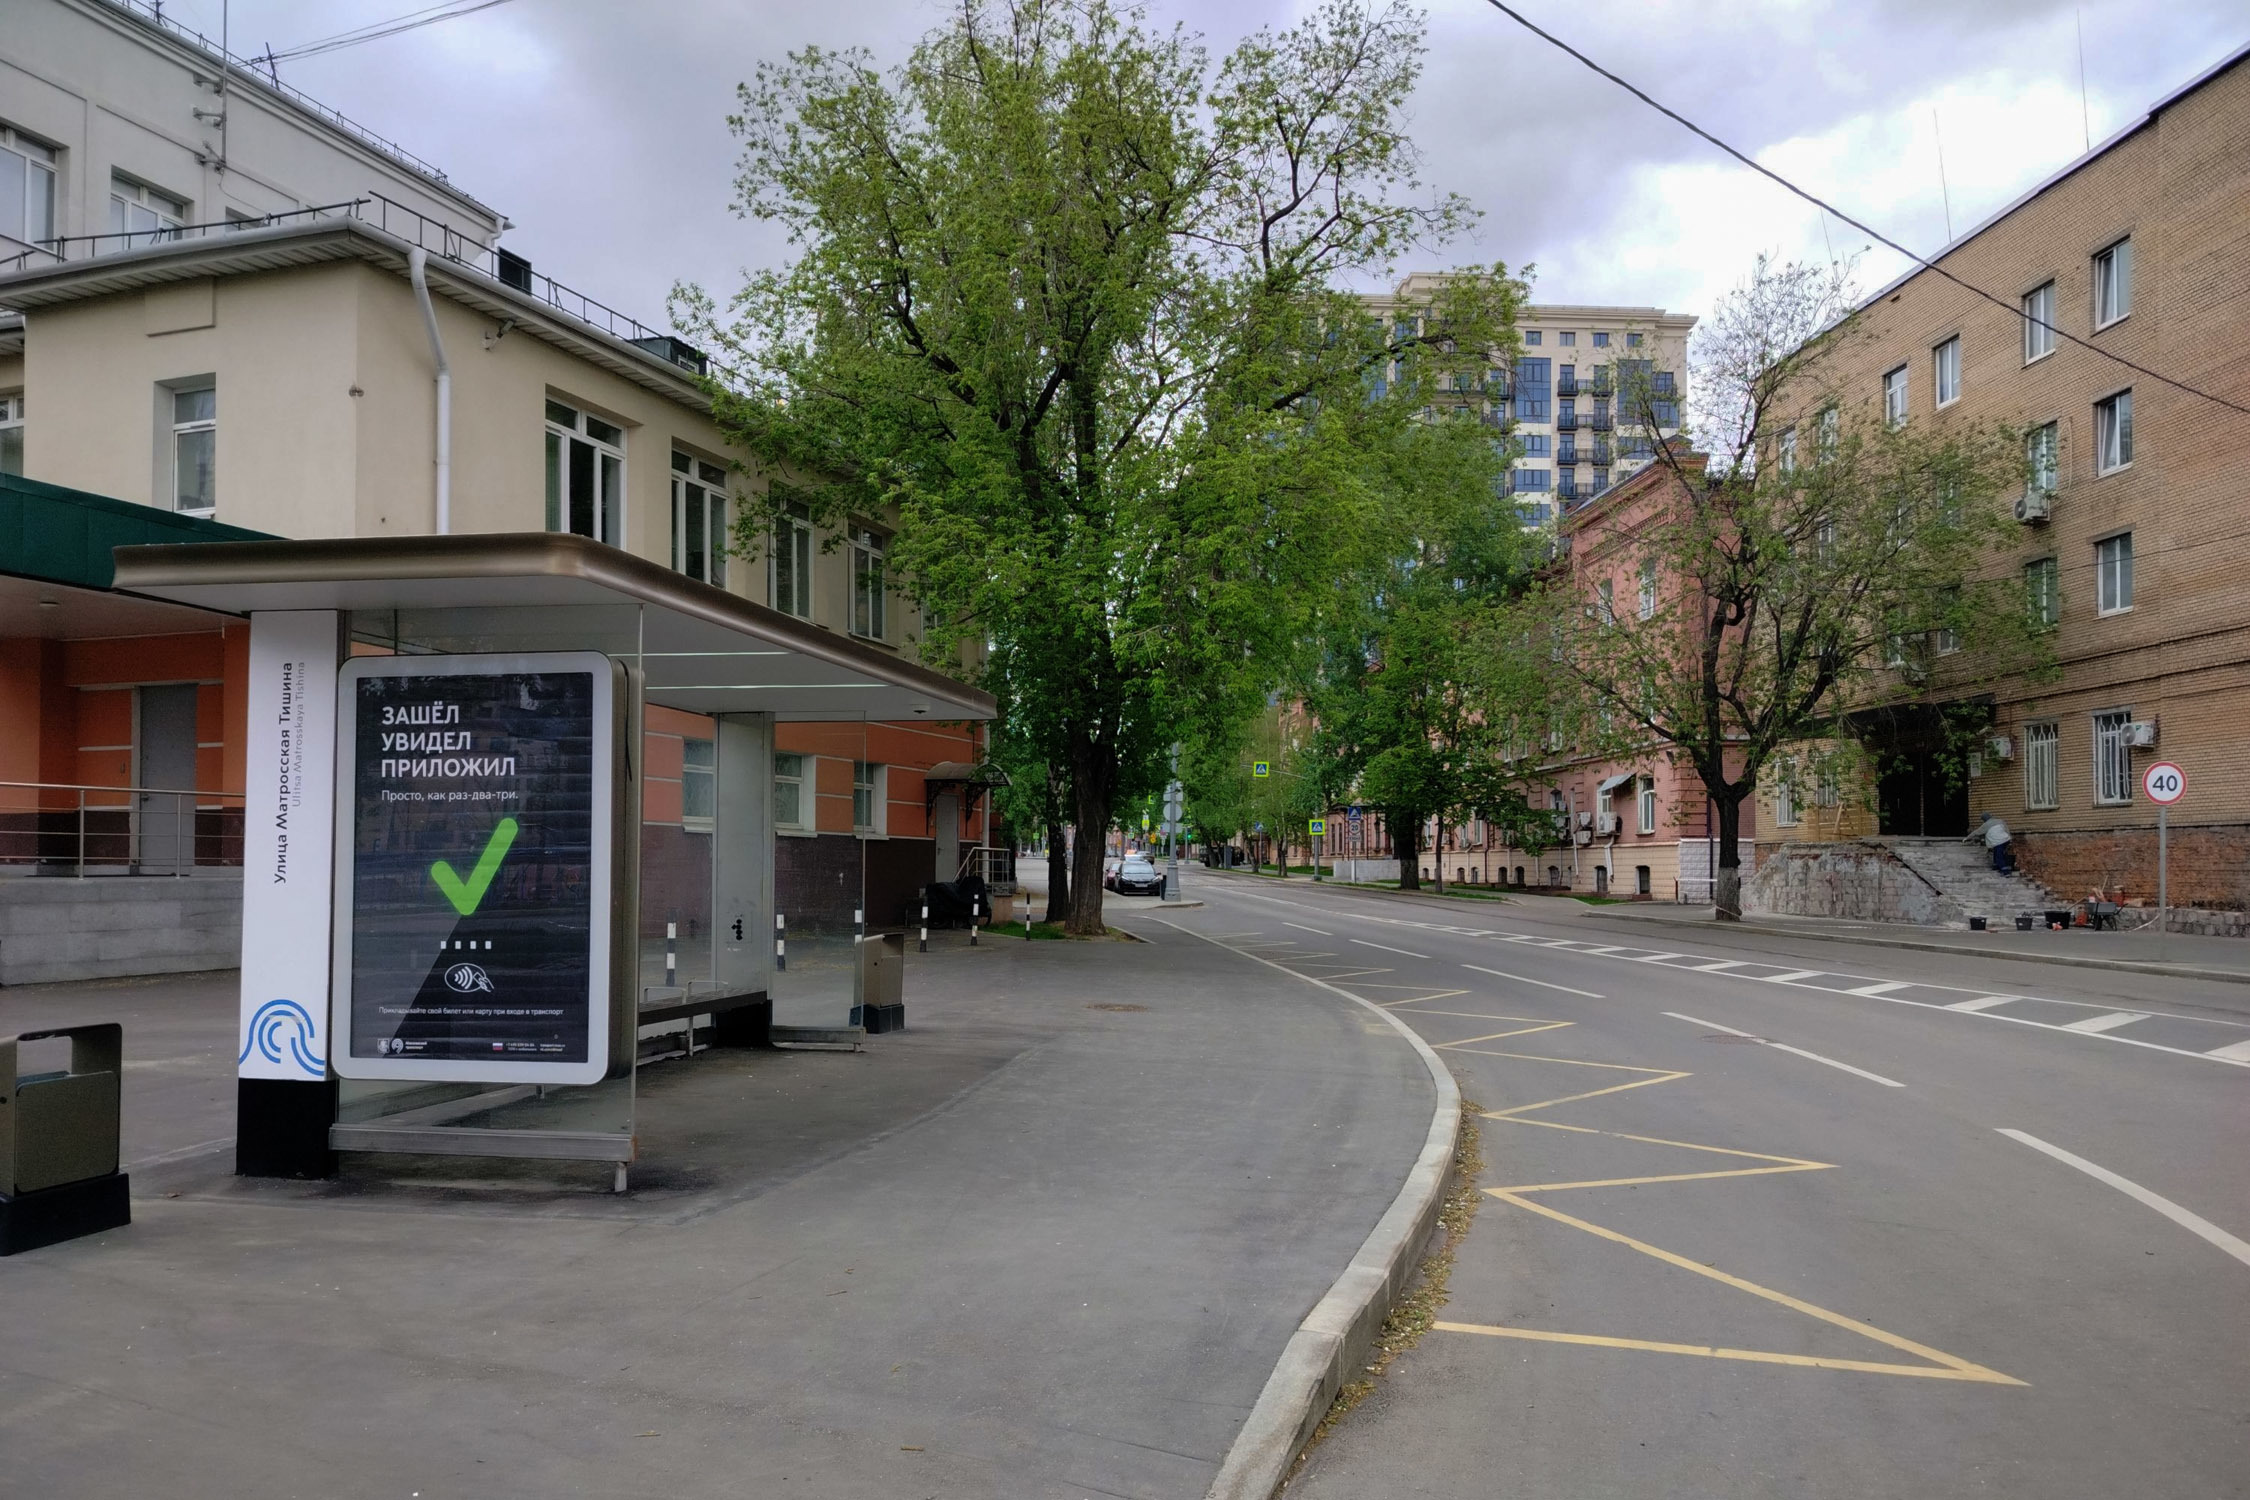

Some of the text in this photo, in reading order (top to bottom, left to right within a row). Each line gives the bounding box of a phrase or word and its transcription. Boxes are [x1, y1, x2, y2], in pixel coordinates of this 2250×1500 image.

[381, 700, 460, 725] ЗАШЁЛ
[292, 662, 305, 807] Ulitsa Matrosskaya Tishina
[381, 731, 471, 754] УВИДЕЛ
[274, 662, 292, 884] Улица Матросская Тишина
[381, 757, 516, 778] ПРИЛОЖИЛ
[2152, 774, 2178, 792] 40
[381, 790, 519, 803] Просто, как раз-два-три.
[427, 1007, 442, 1015] свой
[443, 1007, 461, 1015] билет
